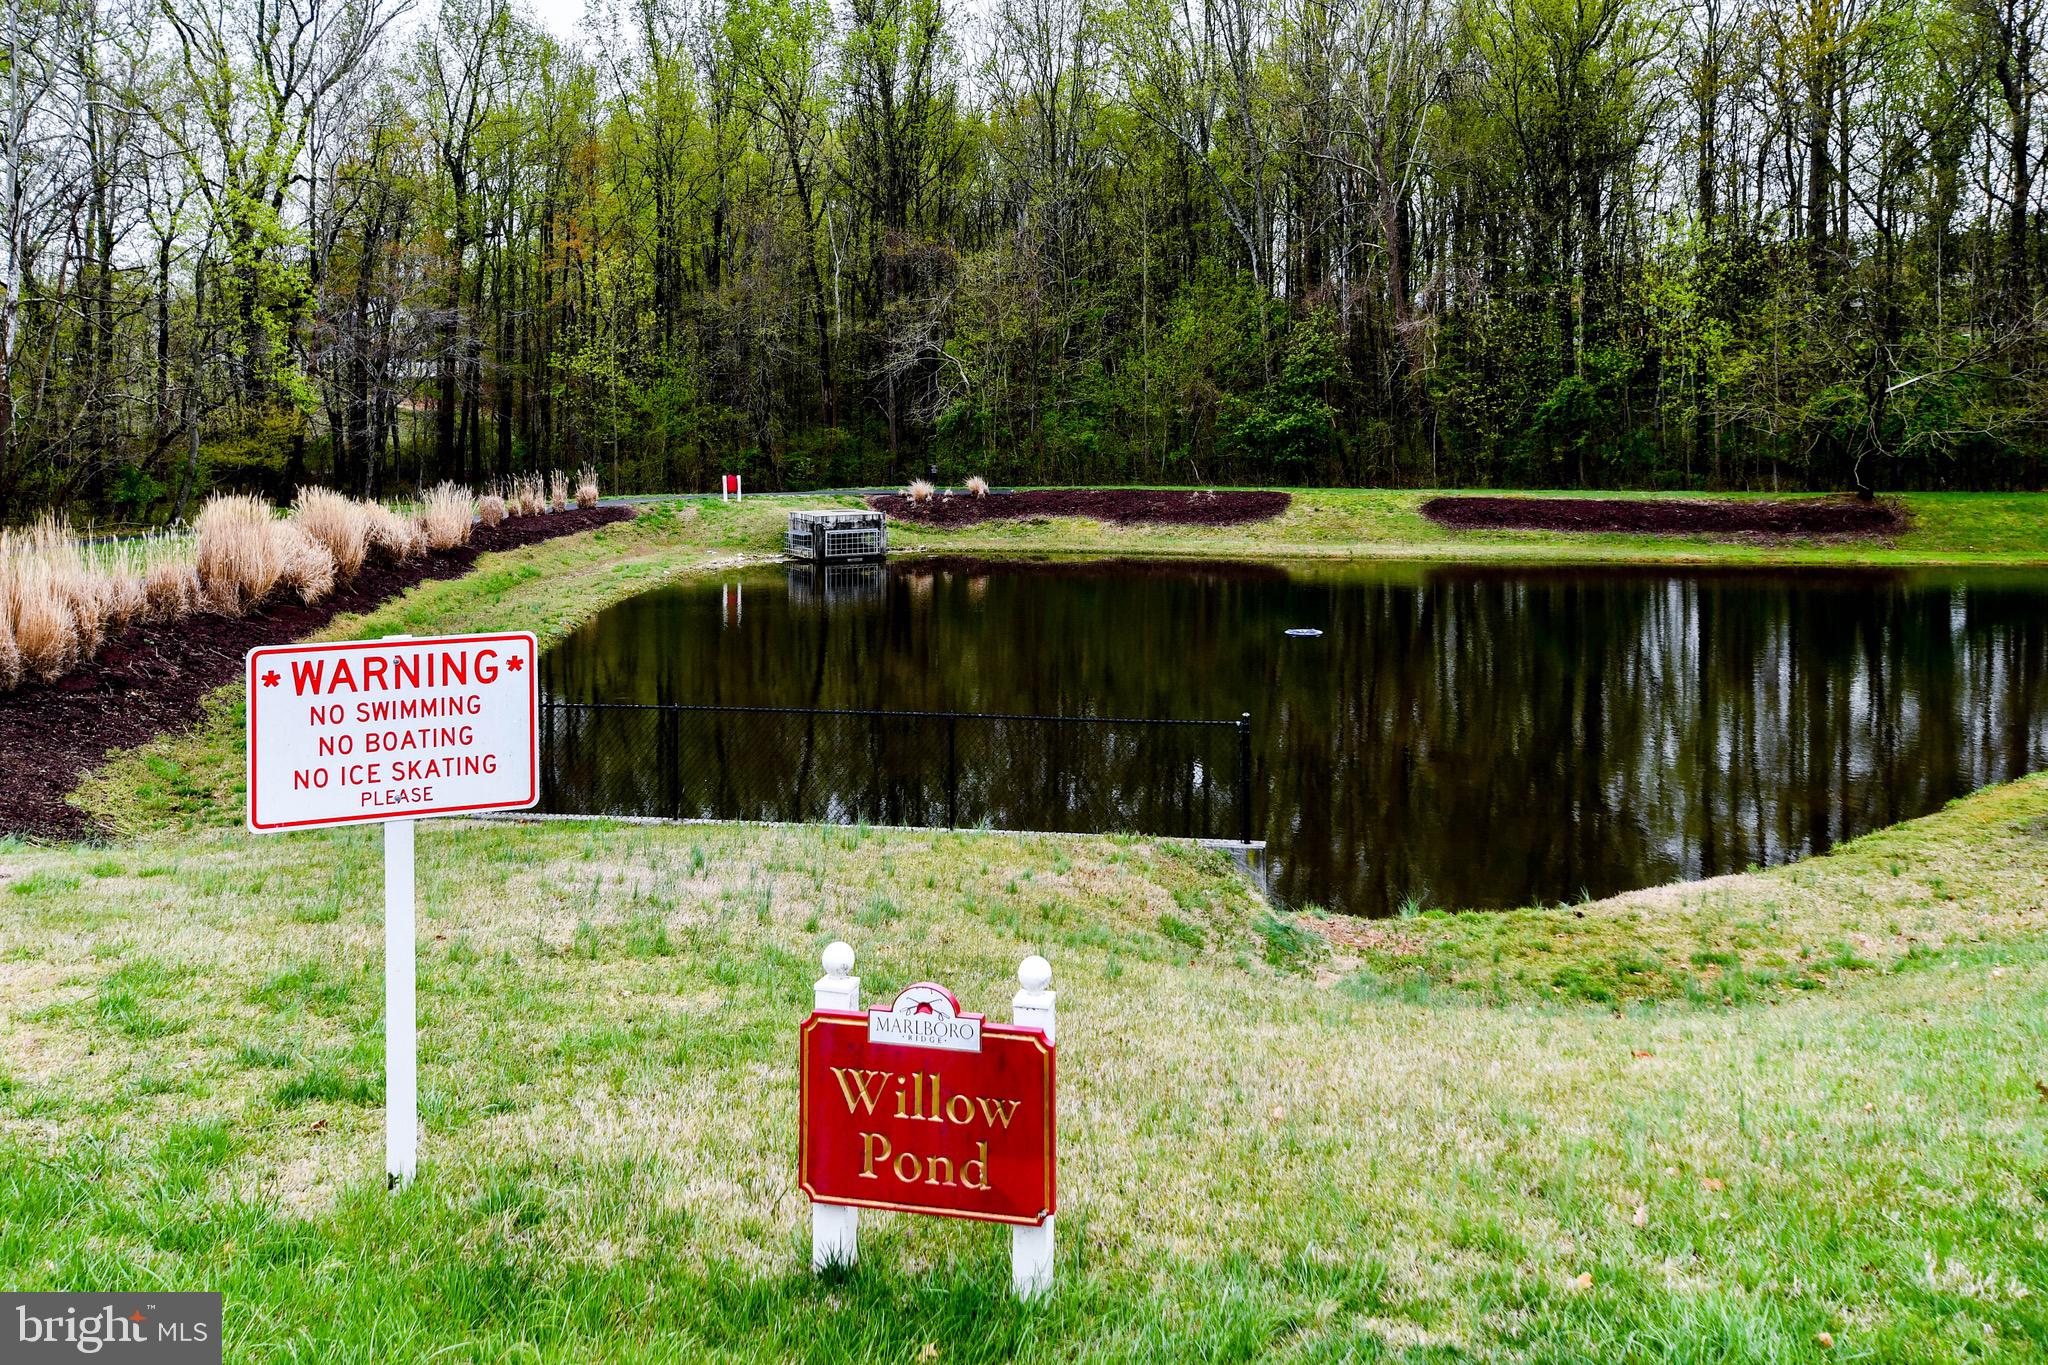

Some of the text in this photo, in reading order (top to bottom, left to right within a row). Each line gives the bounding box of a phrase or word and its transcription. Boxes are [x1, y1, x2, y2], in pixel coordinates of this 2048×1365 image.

[291, 650, 498, 696] WARNING
[310, 695, 481, 726] NO SWIMMING
[319, 726, 473, 756] NO BOATING
[294, 754, 497, 789] NO ICE SKATING
[361, 786, 433, 807] PLEASE
[876, 1017, 974, 1040] MARLBORO
[908, 1034, 942, 1043] RIDGE
[830, 1067, 1021, 1129] Willow
[858, 1132, 992, 1191] Pond
